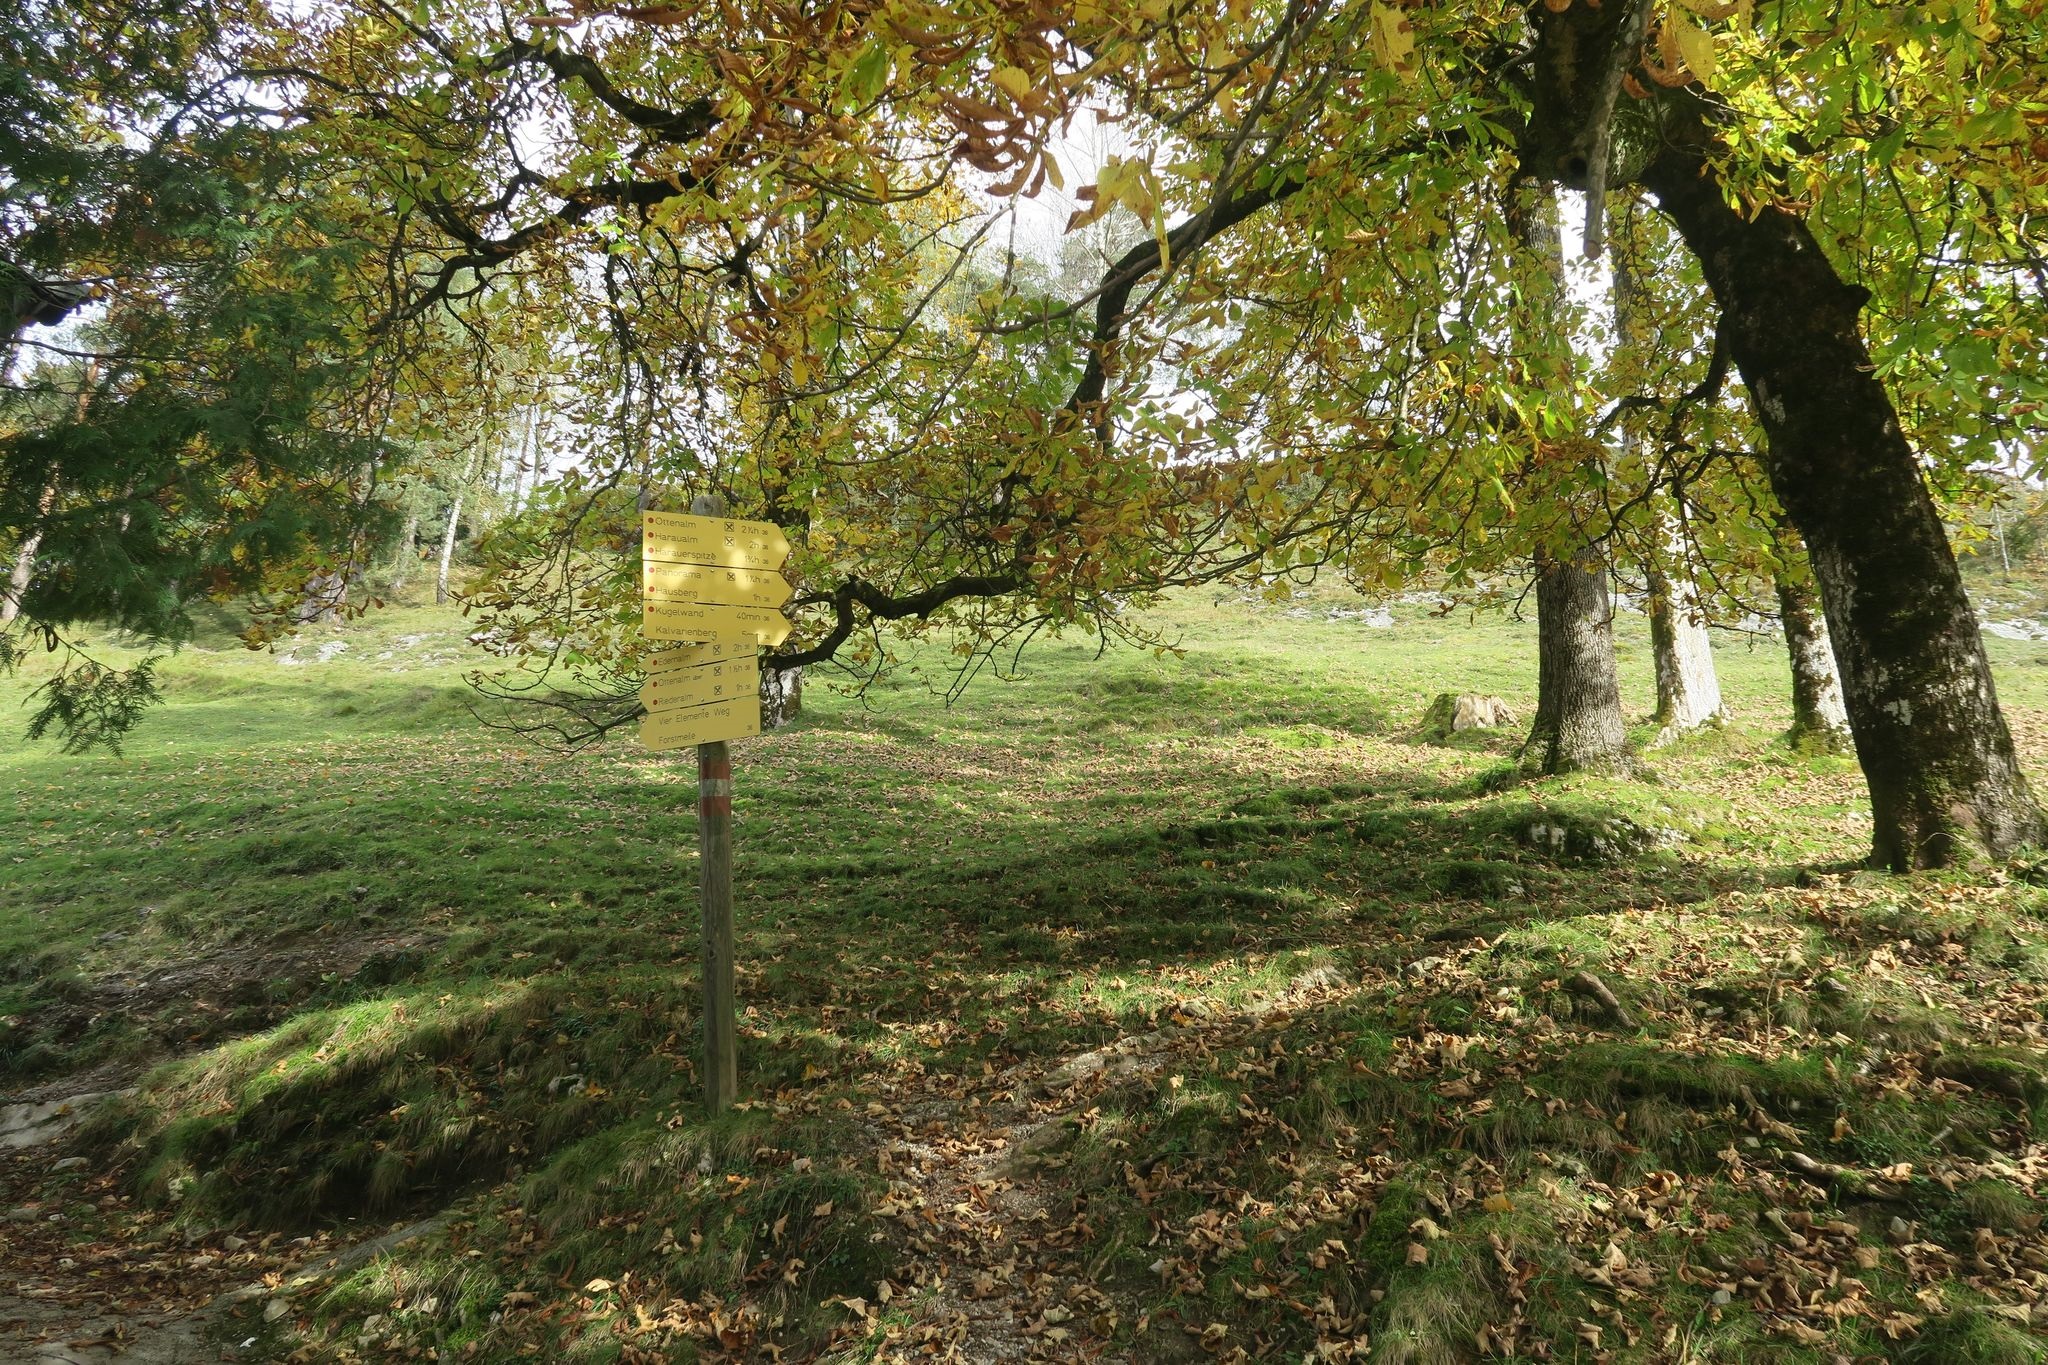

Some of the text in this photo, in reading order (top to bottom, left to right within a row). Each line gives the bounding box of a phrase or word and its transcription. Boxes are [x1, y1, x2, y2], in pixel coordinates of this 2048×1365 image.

[655, 517, 696, 529] Ottenalm
[655, 532, 698, 543] Haraualm
[749, 541, 759, 549] 2h
[655, 568, 702, 579] Panorama
[655, 587, 698, 599] Hausberg
[655, 607, 704, 618] Kugelwand
[736, 612, 761, 621] 40min
[655, 627, 717, 639] Kalvarienberg
[659, 675, 691, 686] Ottenalm
[659, 708, 730, 725] Vier Elemente Weg
